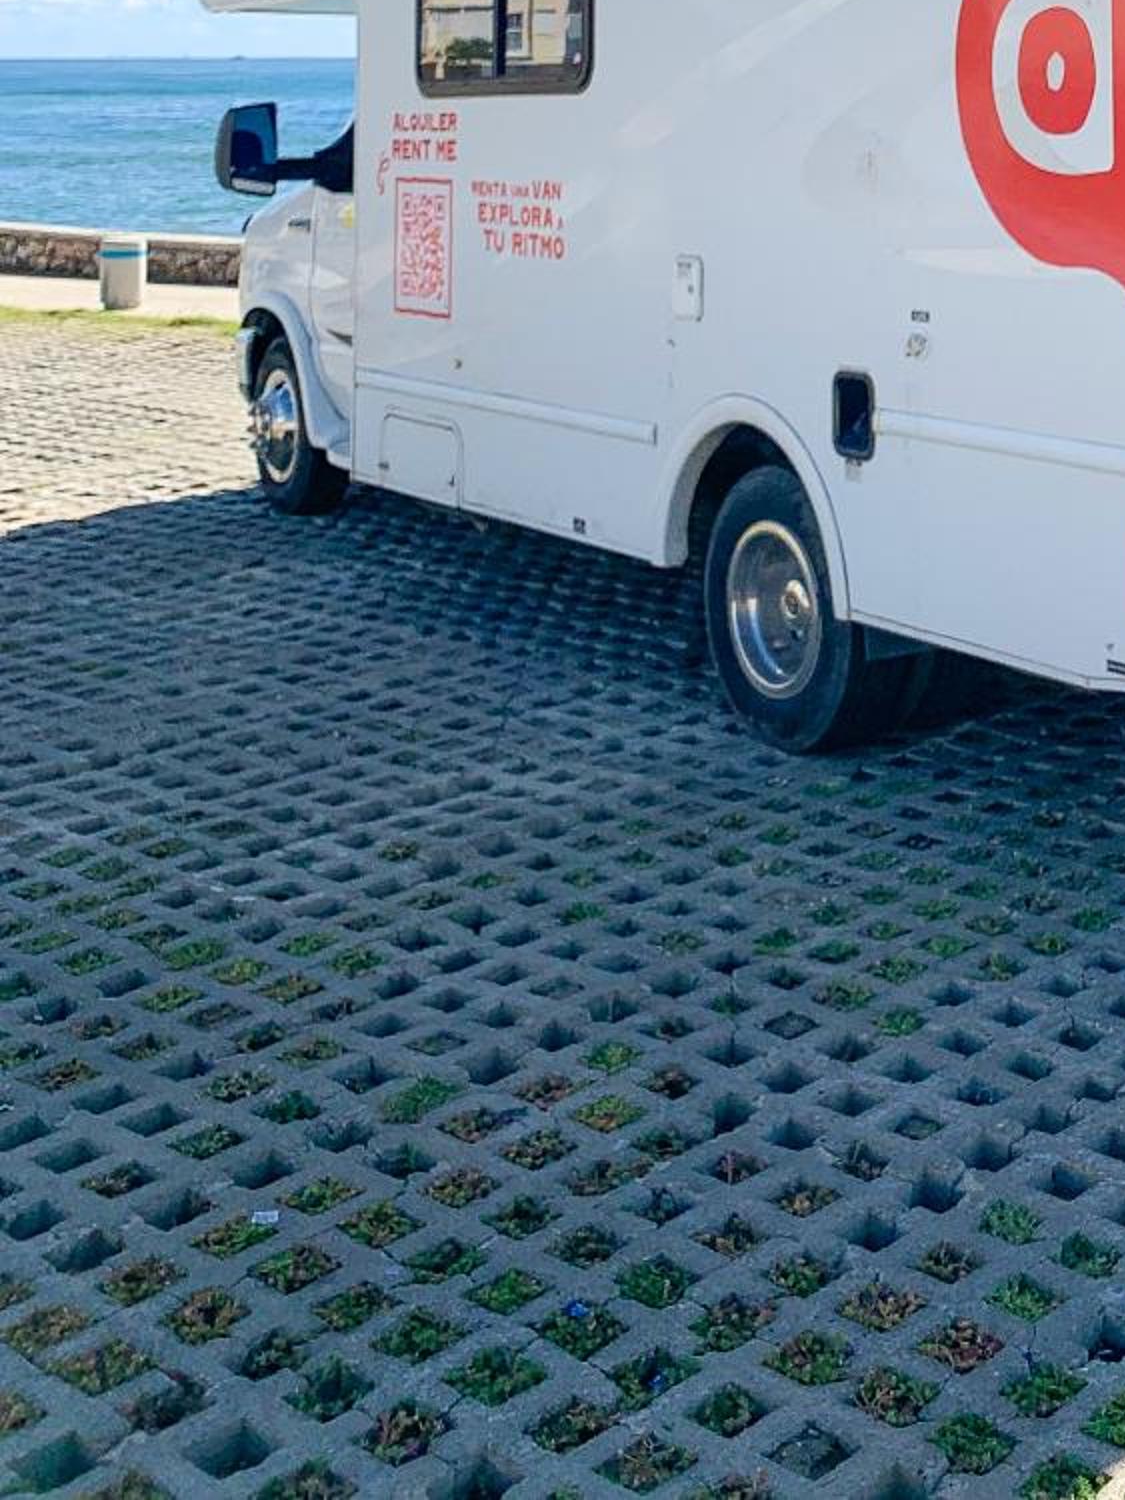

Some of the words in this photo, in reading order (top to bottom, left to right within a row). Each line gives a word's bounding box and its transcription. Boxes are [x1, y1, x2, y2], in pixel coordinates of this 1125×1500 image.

[392, 112, 458, 132] ALQUILER
[391, 139, 431, 160] RENT
[435, 140, 458, 161] ME
[471, 180, 507, 197] RENTA
[532, 180, 562, 201] VAN
[478, 202, 553, 228] EXPLORA
[483, 229, 505, 253] TU
[511, 232, 565, 260] RITMO
